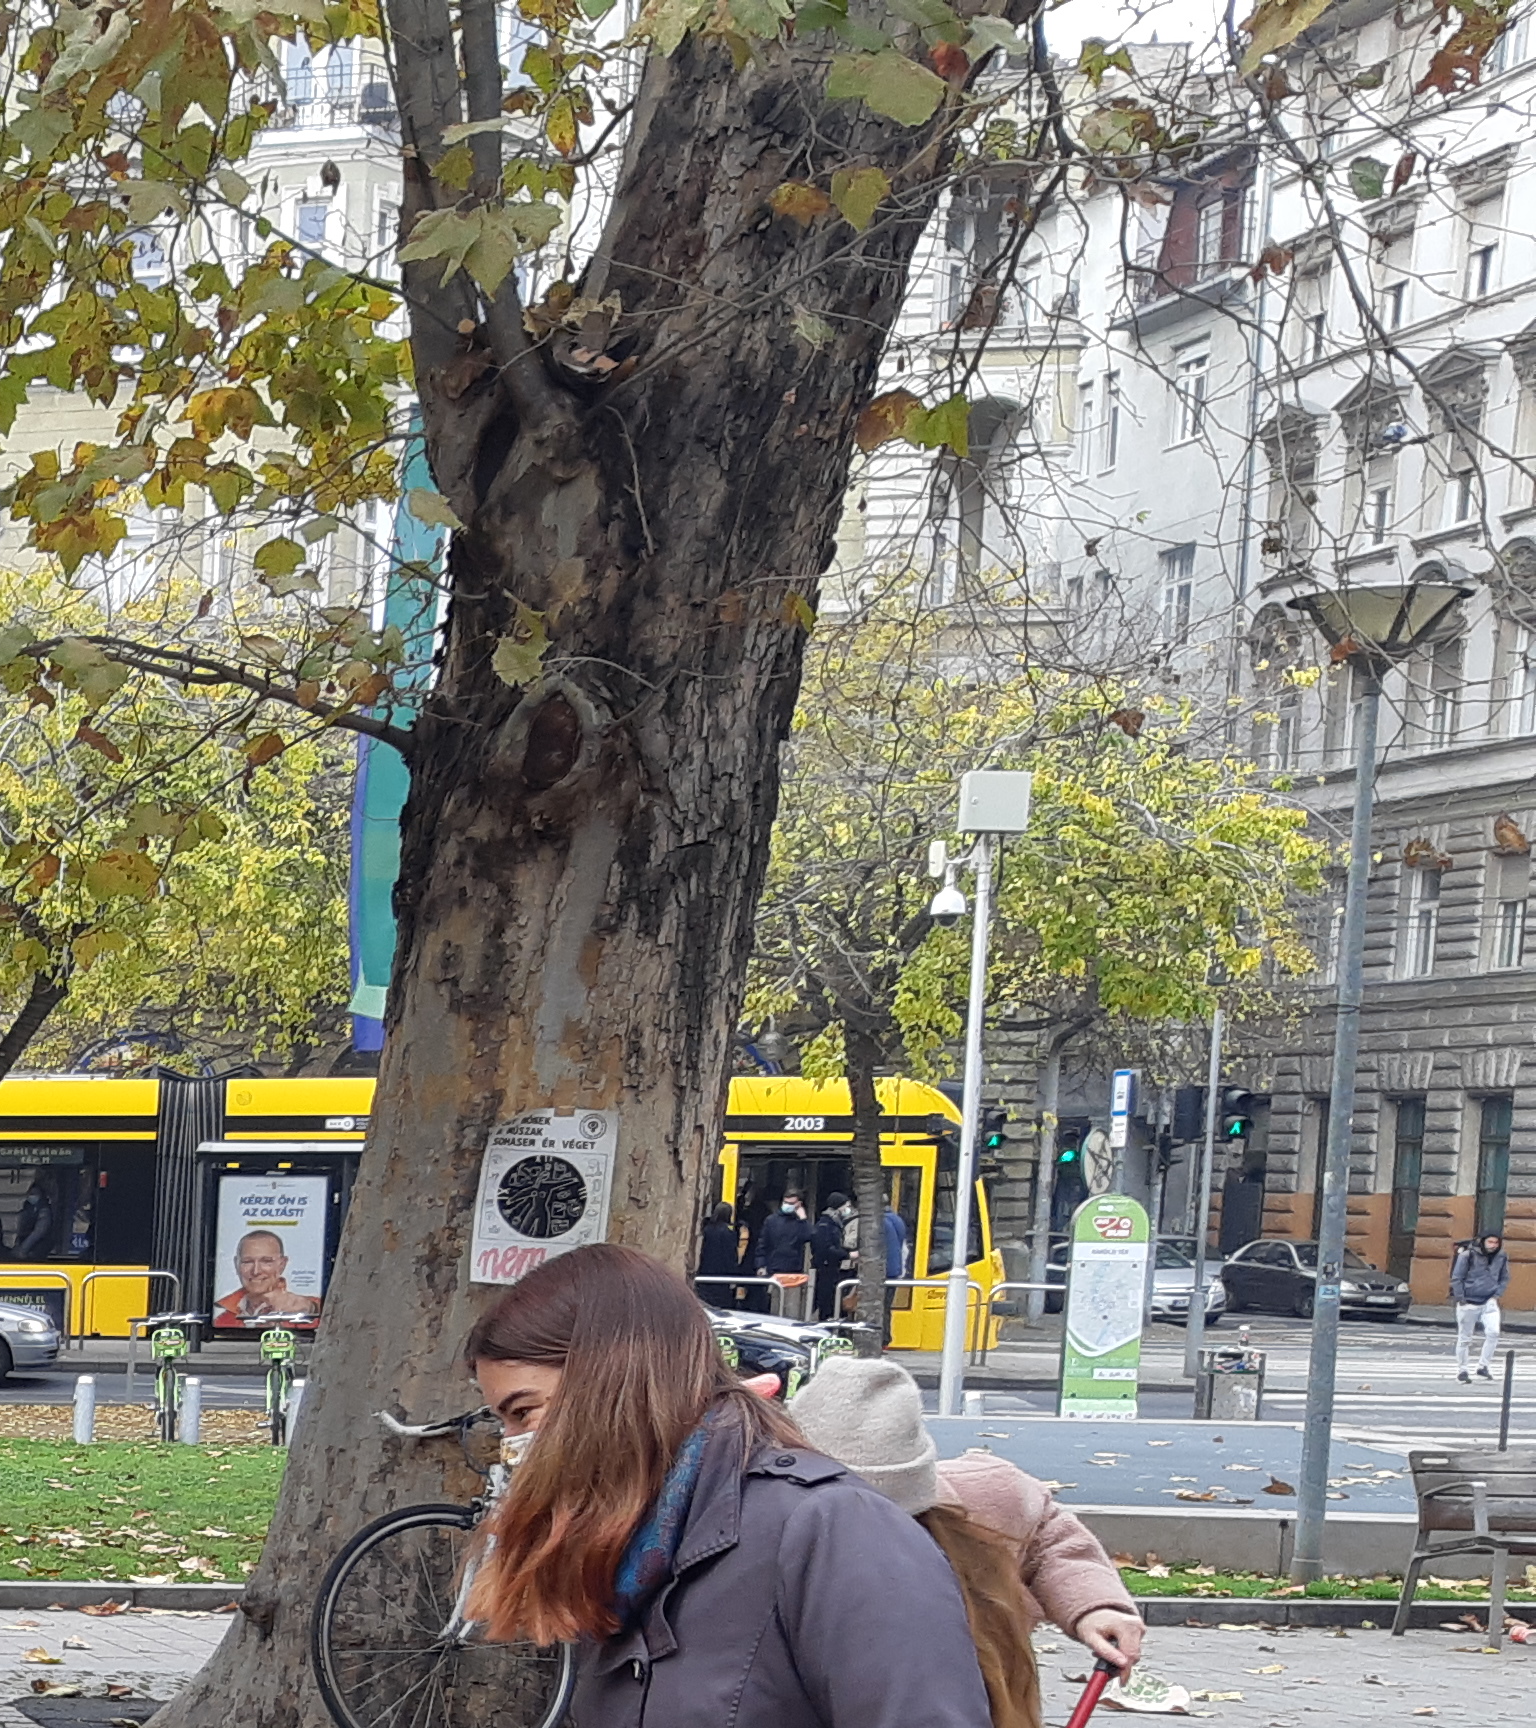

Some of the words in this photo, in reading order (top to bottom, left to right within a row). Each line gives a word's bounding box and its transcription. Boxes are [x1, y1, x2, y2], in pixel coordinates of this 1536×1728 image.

[784, 1117, 825, 1131] 2003
[491, 1137, 536, 1148] SOHASEM
[541, 1136, 556, 1149] ÉR
[561, 1138, 597, 1150] VÉGET
[239, 1193, 276, 1206] KÉRJE
[296, 1196, 308, 1206] IS
[242, 1207, 259, 1217] AZ
[260, 1205, 305, 1218] OLTÁST!
